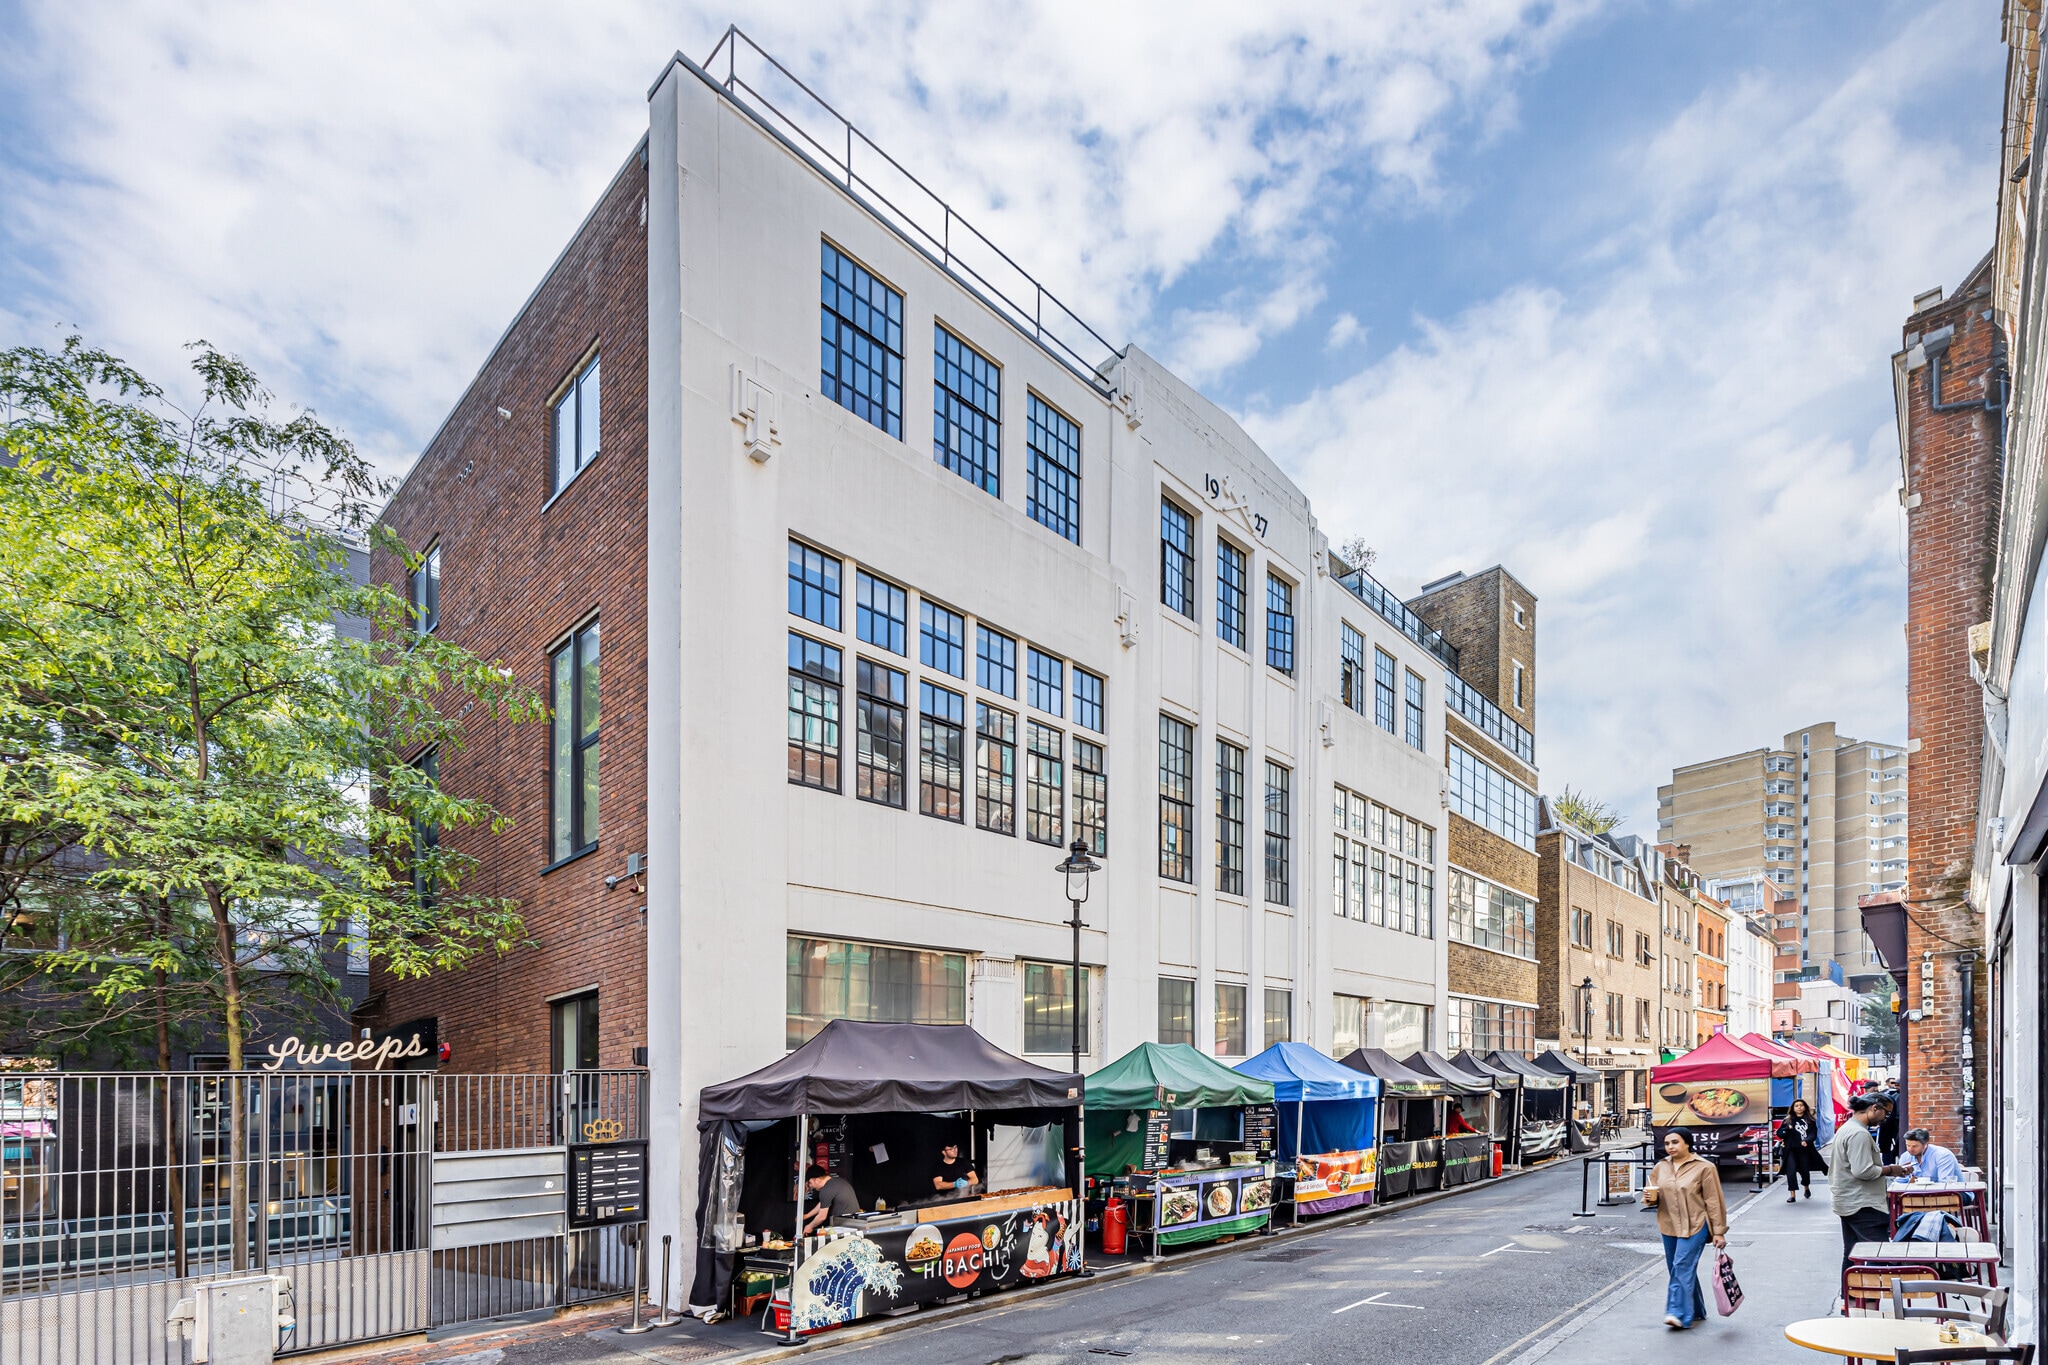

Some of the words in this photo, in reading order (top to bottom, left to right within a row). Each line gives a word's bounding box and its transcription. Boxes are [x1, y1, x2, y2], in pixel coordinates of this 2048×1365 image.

[1205, 473, 1220, 499] 19
[1254, 513, 1269, 538] 27
[262, 1033, 429, 1071] Sweeps
[946, 1245, 969, 1254] JAPANESE
[968, 1243, 981, 1251] FOOD
[923, 1249, 1000, 1280] HIBACHI
